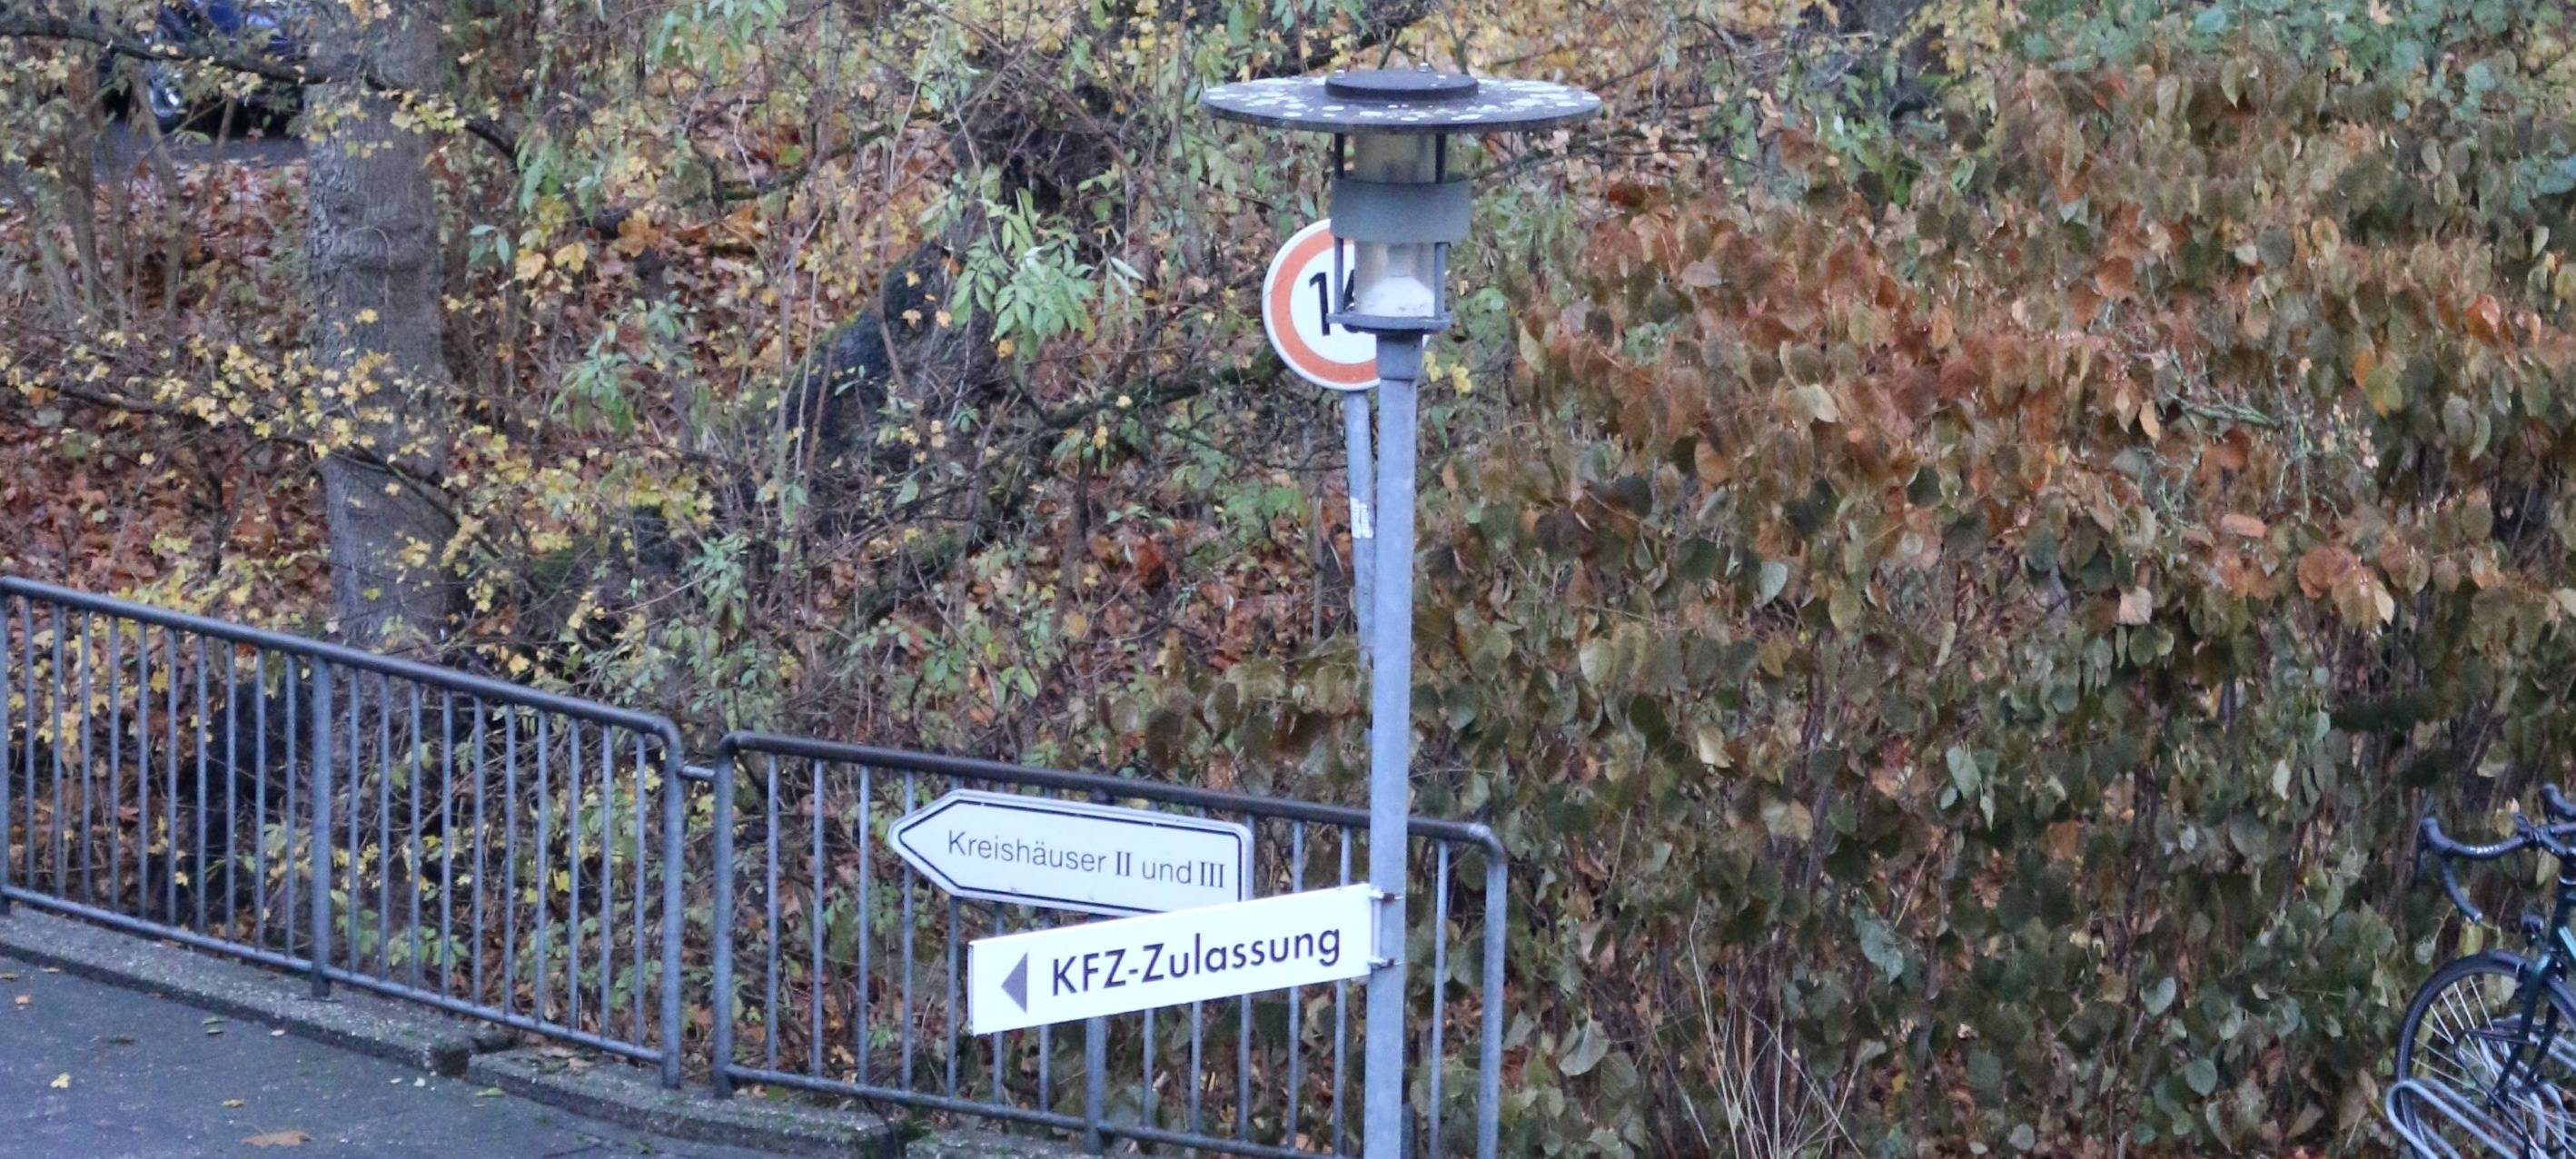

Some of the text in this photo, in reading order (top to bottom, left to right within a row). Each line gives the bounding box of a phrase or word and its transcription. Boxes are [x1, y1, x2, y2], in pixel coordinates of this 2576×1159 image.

[947, 829, 1226, 889] Kreishäuser II und III
[1052, 927, 1341, 997] KFZ-Zulassung
